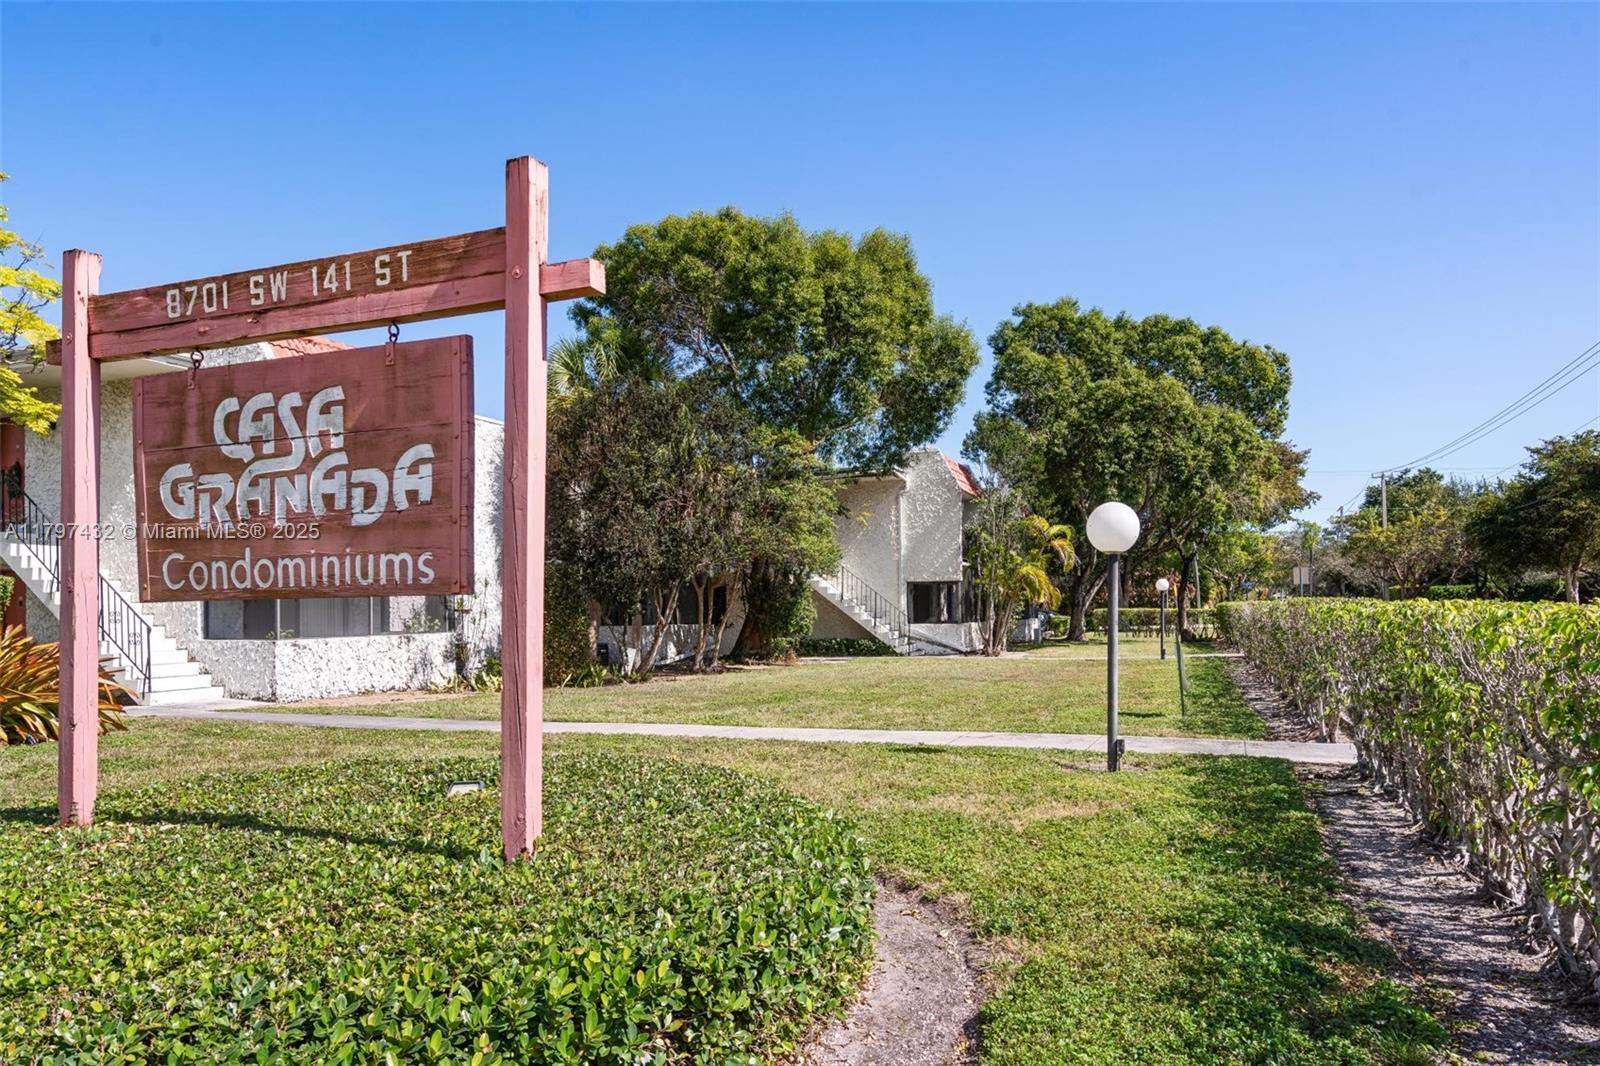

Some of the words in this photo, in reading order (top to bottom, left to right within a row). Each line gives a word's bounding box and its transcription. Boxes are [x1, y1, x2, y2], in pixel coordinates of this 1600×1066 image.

[167, 281, 229, 319] 8701
[249, 270, 288, 306] SW
[312, 260, 352, 297] 141
[375, 250, 412, 286] ST
[213, 385, 346, 467] CASA
[159, 443, 435, 530] GRANADA
[162, 547, 435, 591] Condominiums
